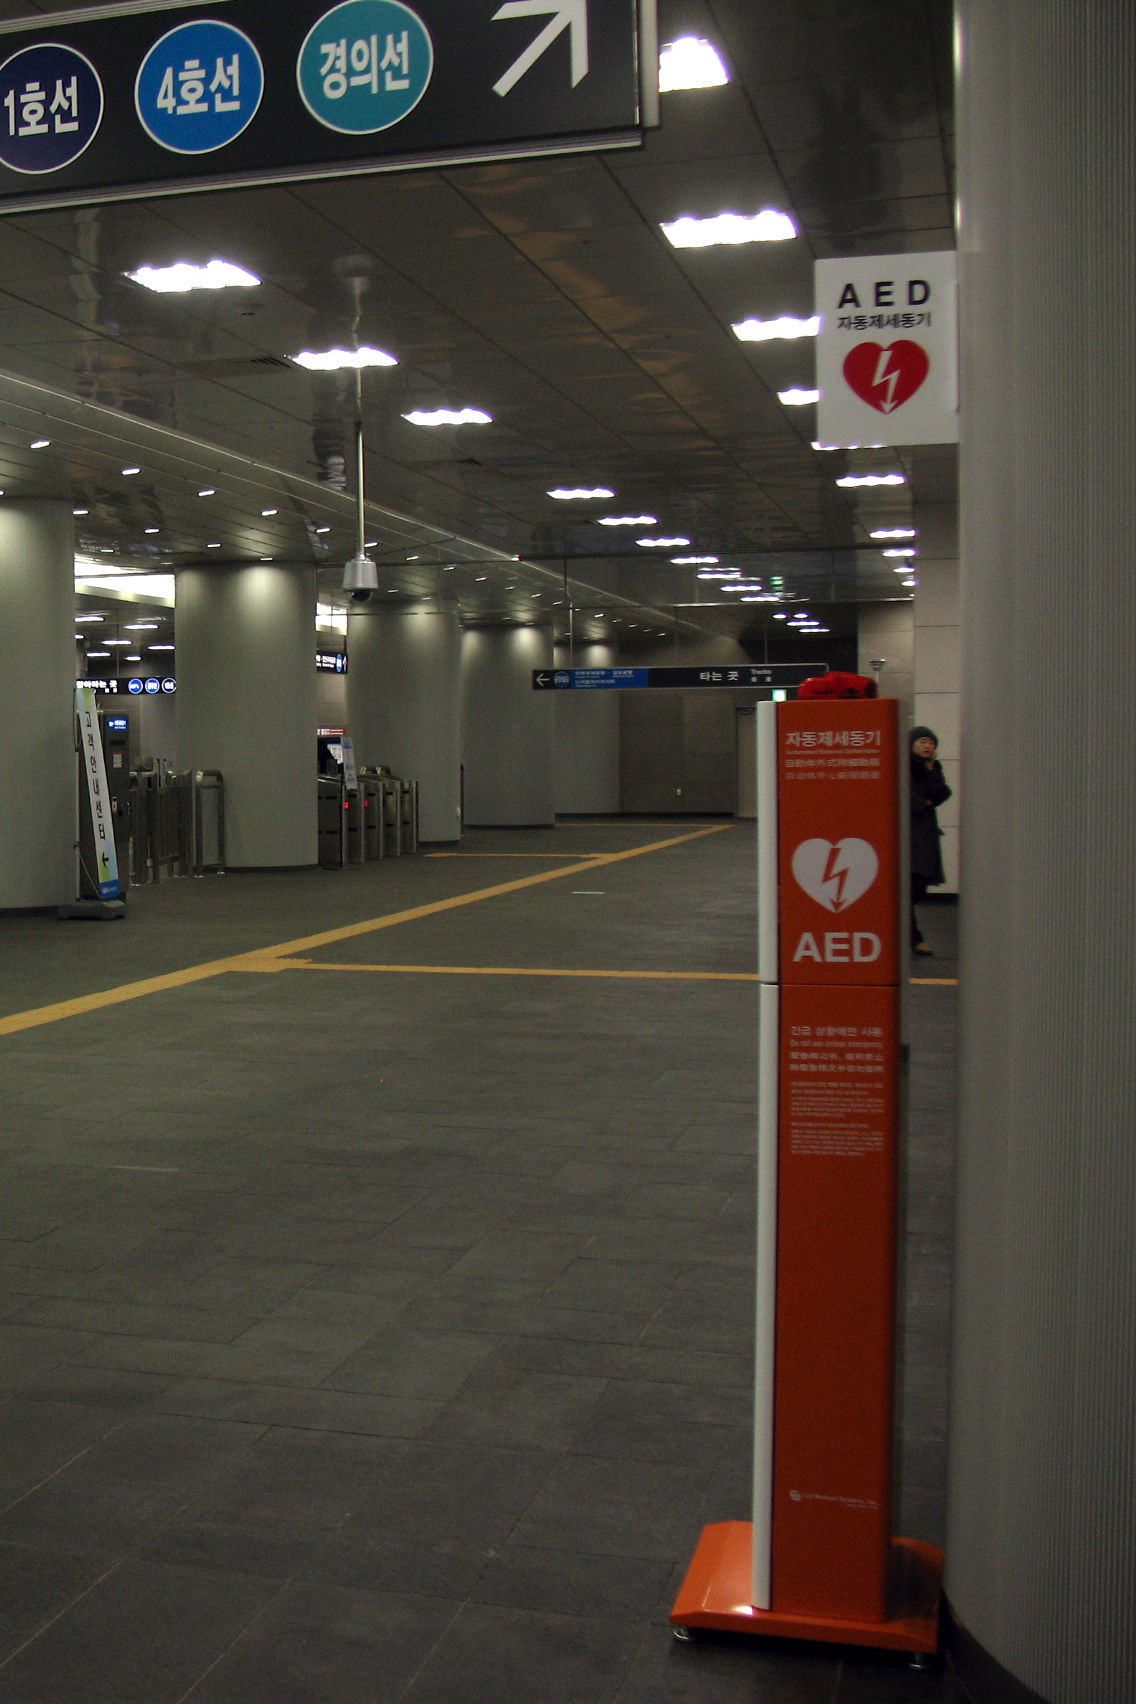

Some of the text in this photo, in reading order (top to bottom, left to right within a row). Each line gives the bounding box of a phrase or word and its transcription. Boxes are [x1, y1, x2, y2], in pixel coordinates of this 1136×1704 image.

[319, 31, 410, 100] 경의선
[156, 54, 241, 116] 4호선
[3, 75, 80, 137] 1호선
[837, 280, 931, 309] AED
[837, 312, 932, 330] 자동제세동기
[699, 671, 723, 682] 타는
[727, 671, 740, 682] 곳
[785, 730, 881, 748] 자동제세동기
[793, 932, 881, 963] AED
